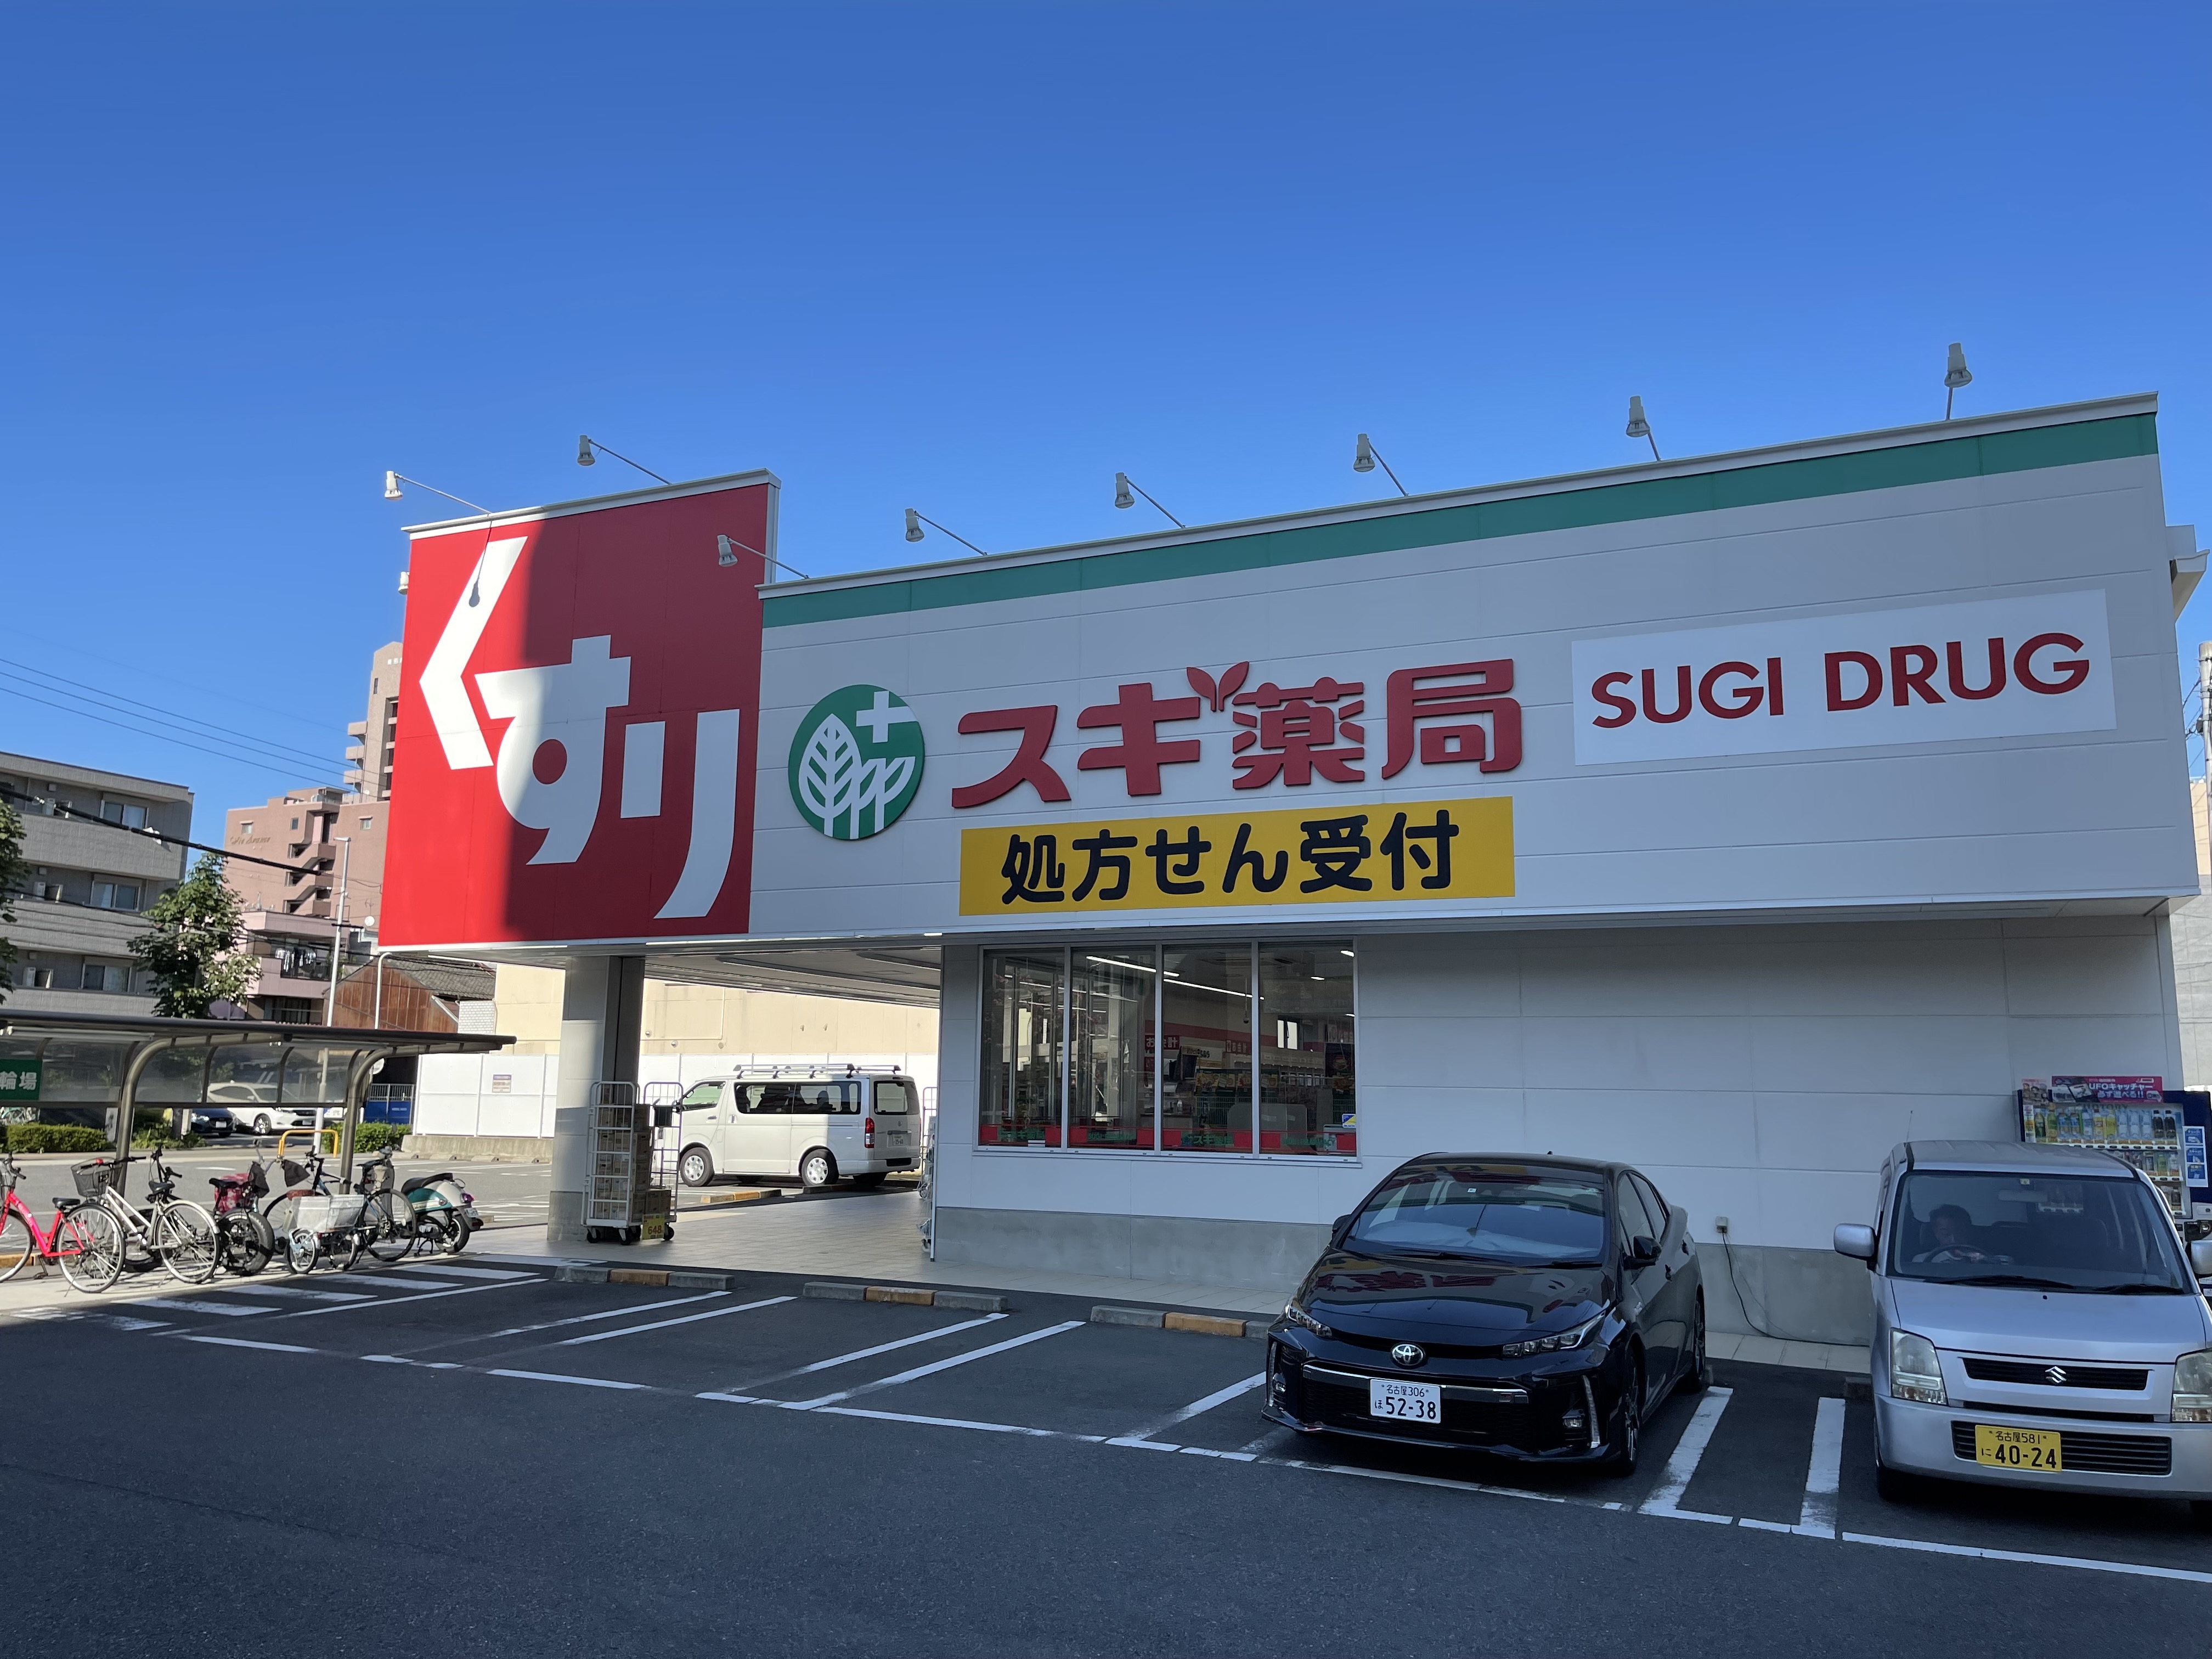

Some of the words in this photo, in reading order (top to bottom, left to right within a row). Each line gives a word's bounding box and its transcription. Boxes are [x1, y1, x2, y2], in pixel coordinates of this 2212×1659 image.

[1591, 657, 1784, 729] SUGI
[1824, 633, 2090, 713] DRUG
[419, 535, 741, 920] くすり
[952, 658, 1522, 809] スギ薬局
[1001, 809, 1459, 905] 処方せん受付
[648, 1225, 662, 1234] 648
[1386, 1384, 1425, 1397] 名古屋306
[1374, 1400, 1383, 1409] ほ
[1386, 1396, 1436, 1420] 52-38
[1995, 1431, 2040, 1444] 名古屋581
[1982, 1448, 1991, 1457] に
[1995, 1444, 2057, 1469] 40-24
